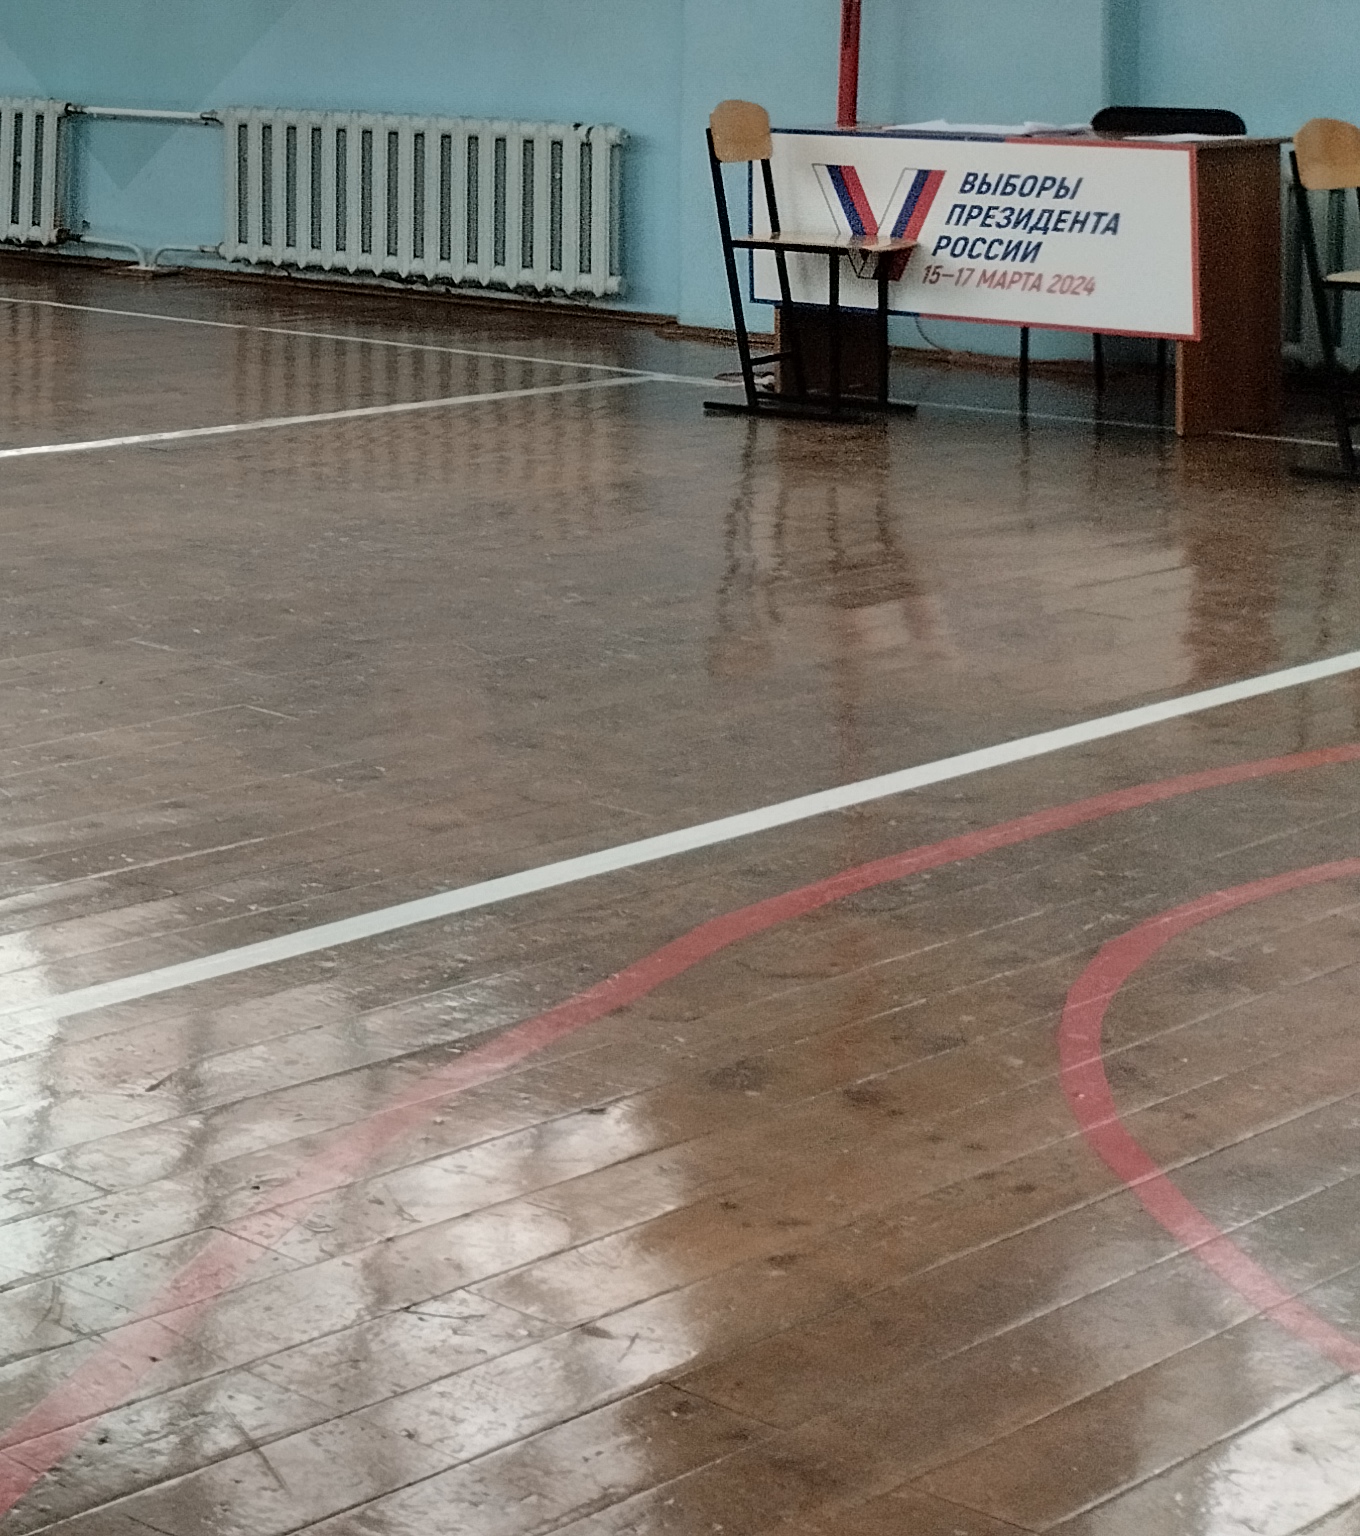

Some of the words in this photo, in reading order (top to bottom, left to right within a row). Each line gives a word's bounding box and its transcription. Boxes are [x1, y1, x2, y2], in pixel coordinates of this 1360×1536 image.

[959, 172, 1084, 199] ВЫБОРЫ
[944, 203, 1121, 236] ПРЕЗИДЕНТА
[931, 235, 1044, 264] РОССИИ
[976, 269, 1043, 293] МАРТА
[1046, 274, 1096, 296] 2024
